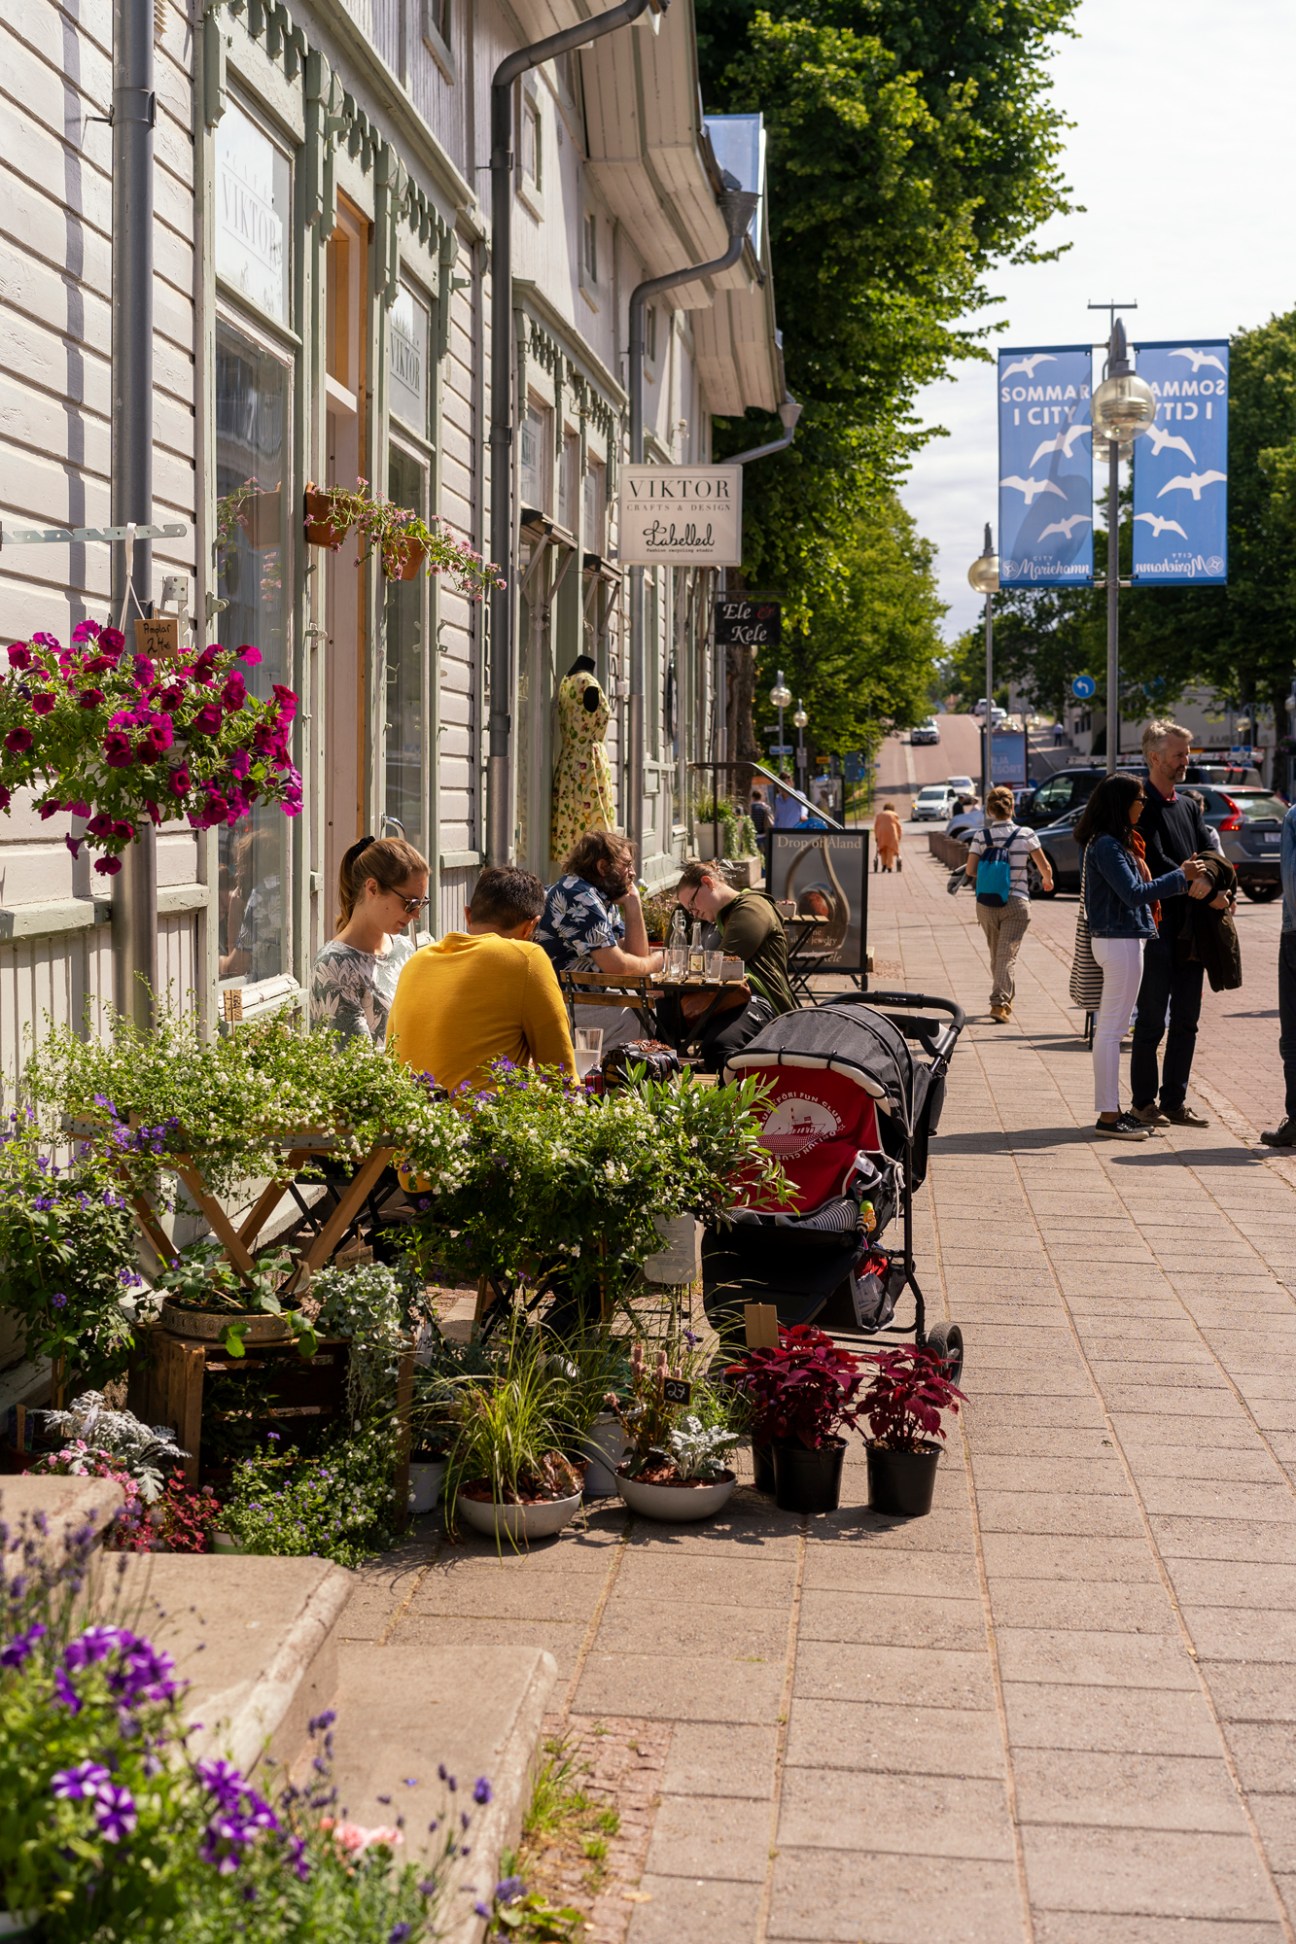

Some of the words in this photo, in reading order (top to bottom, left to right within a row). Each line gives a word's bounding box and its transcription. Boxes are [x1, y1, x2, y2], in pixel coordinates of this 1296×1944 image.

[222, 172, 278, 269] VIKTOR
[391, 332, 420, 392] VIKTOR
[1001, 384, 1090, 403] SOMMAR
[1013, 408, 1020, 426] I
[1027, 406, 1077, 425] CITY
[628, 479, 731, 498] VIKTOR
[627, 503, 670, 511] CRAFTS
[677, 503, 683, 511] &
[690, 503, 731, 511] DESIGN
[642, 519, 715, 547] Labelled
[1014, 558, 1090, 580] Mariehamn
[723, 603, 751, 619] Ele
[731, 624, 767, 643] Kele
[777, 836, 808, 851] Drop
[800, 1092, 818, 1102] FUN
[822, 1101, 842, 1123] CLUB
[666, 1381, 686, 1399] 27
